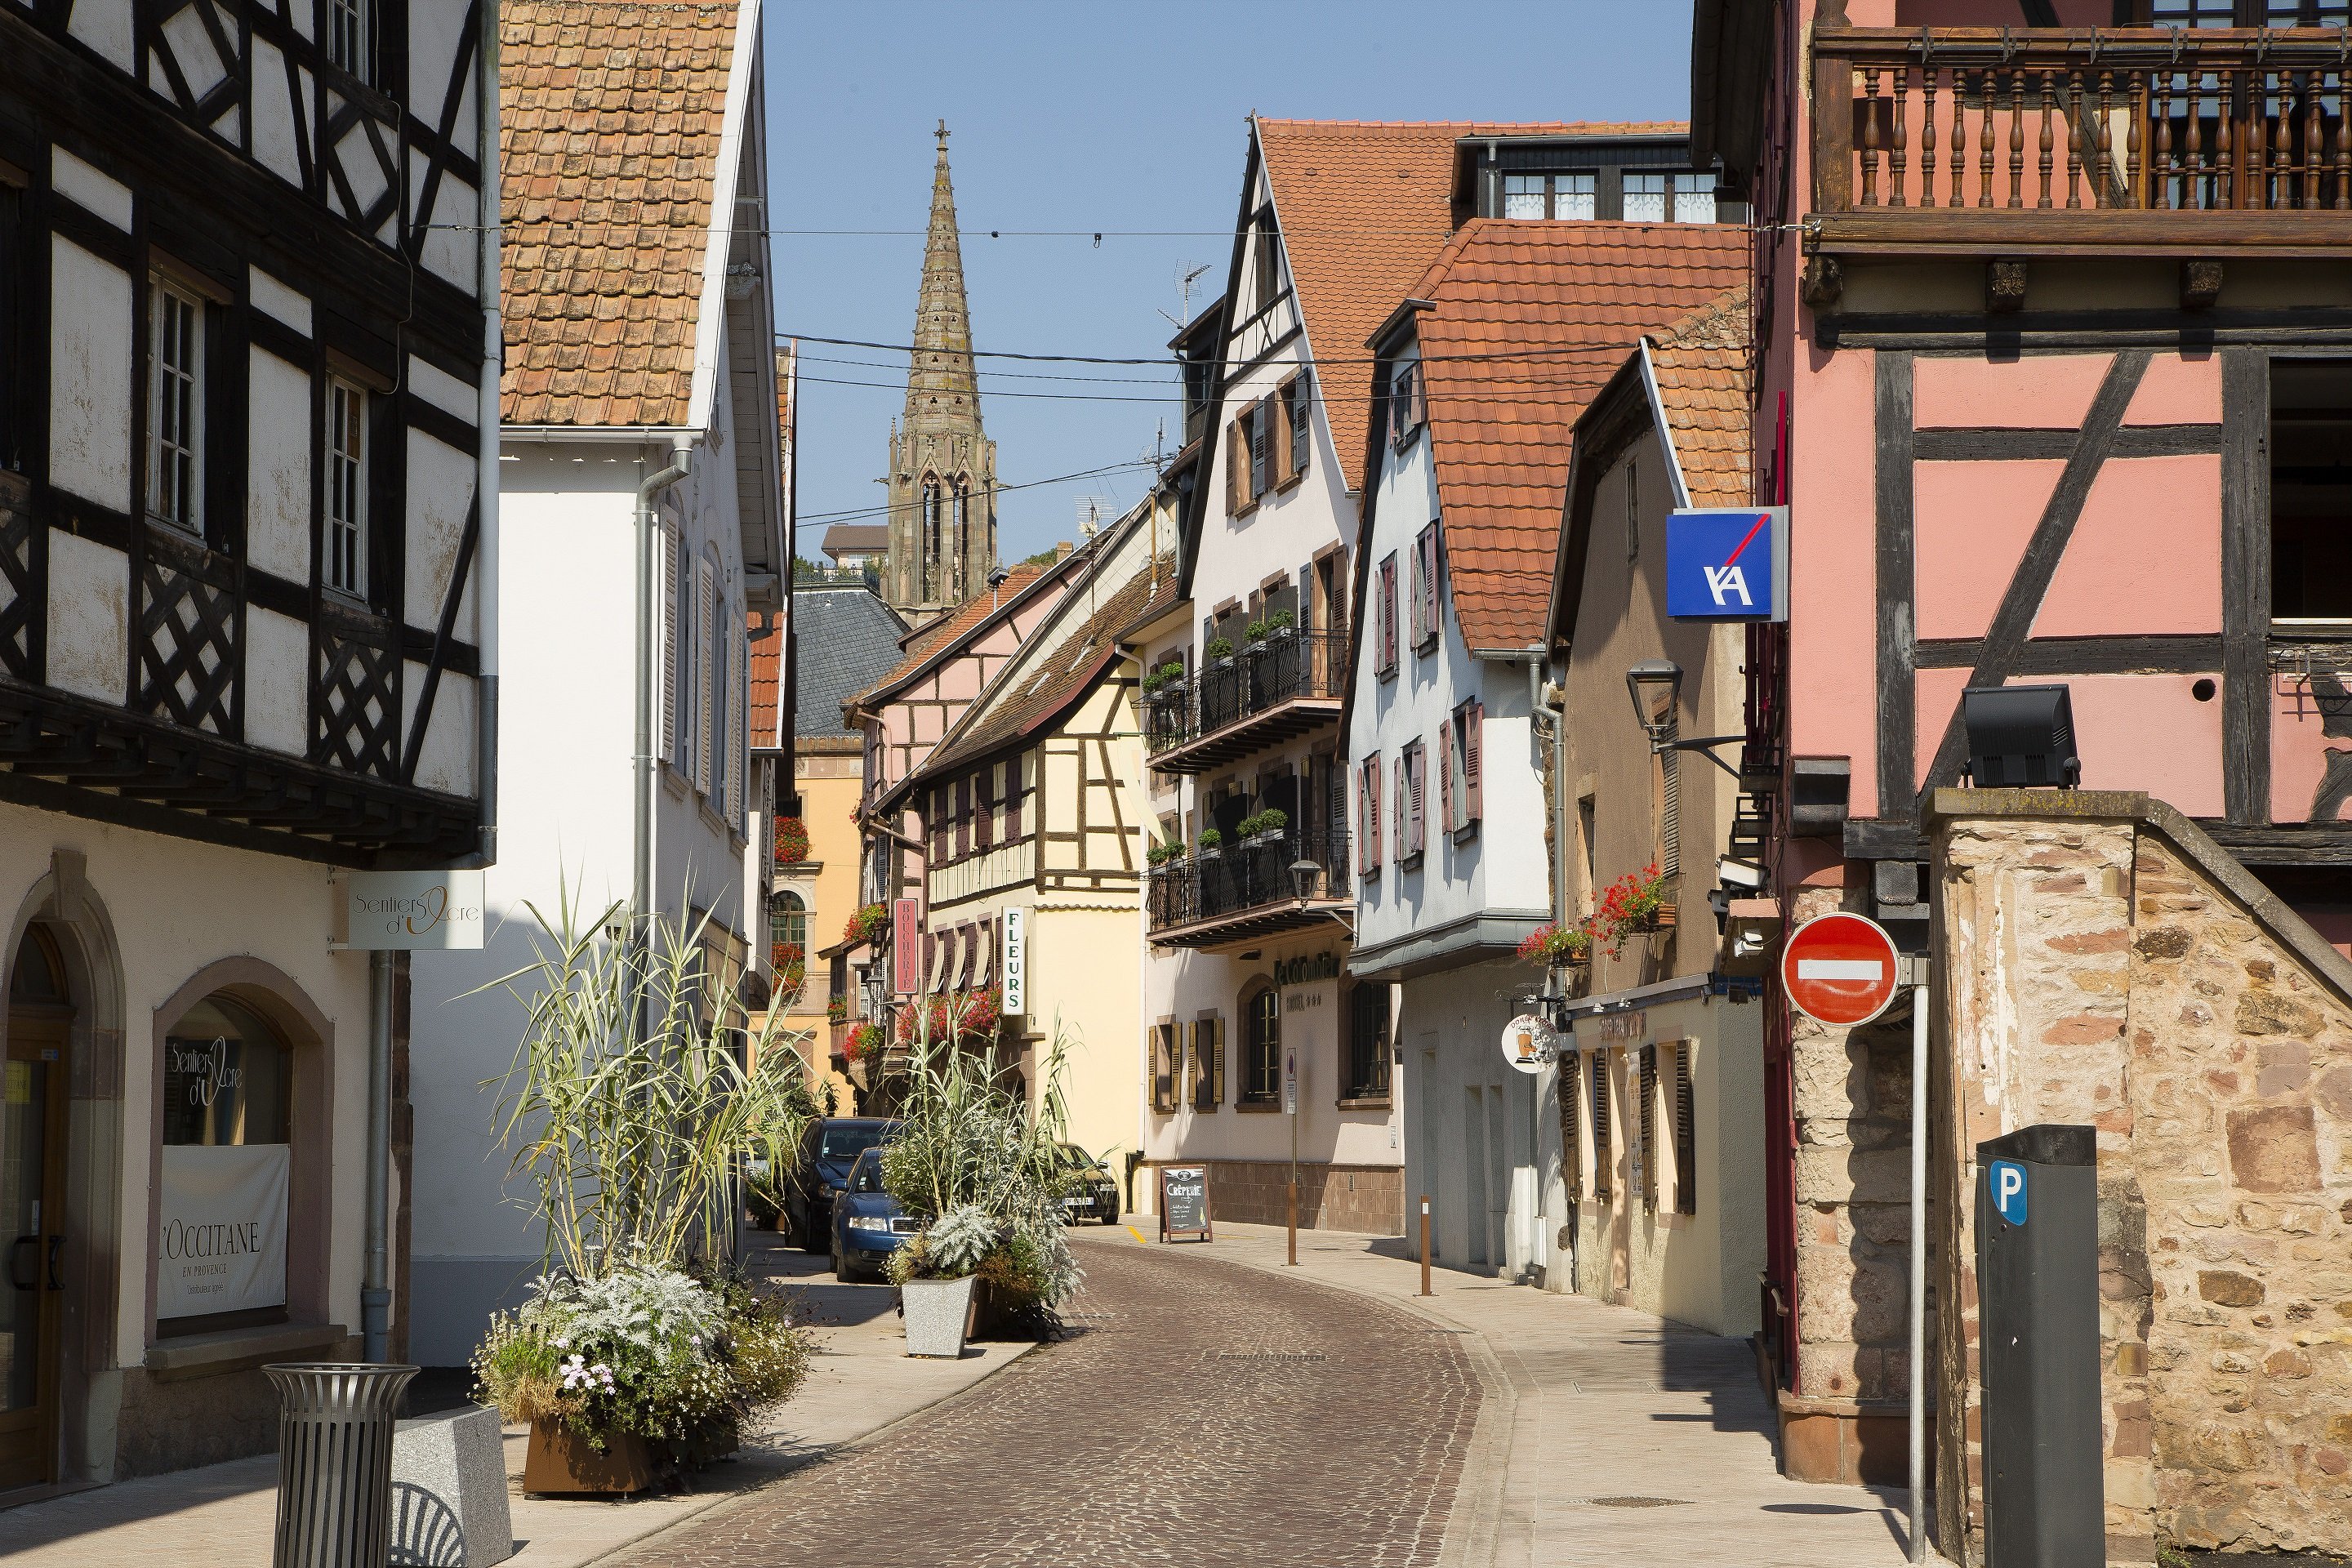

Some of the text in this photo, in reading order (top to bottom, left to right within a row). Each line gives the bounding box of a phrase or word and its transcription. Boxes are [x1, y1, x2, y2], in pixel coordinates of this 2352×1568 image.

[353, 893, 426, 920] Sentiers
[902, 903, 911, 989] BOUCHERIE
[1009, 913, 1019, 1007] FLEURS
[171, 1043, 214, 1084] Sentiers
[2000, 1167, 2022, 1212] P
[158, 1218, 261, 1259] 'OCCITANE
[182, 1263, 227, 1277] EN PROVENCE
